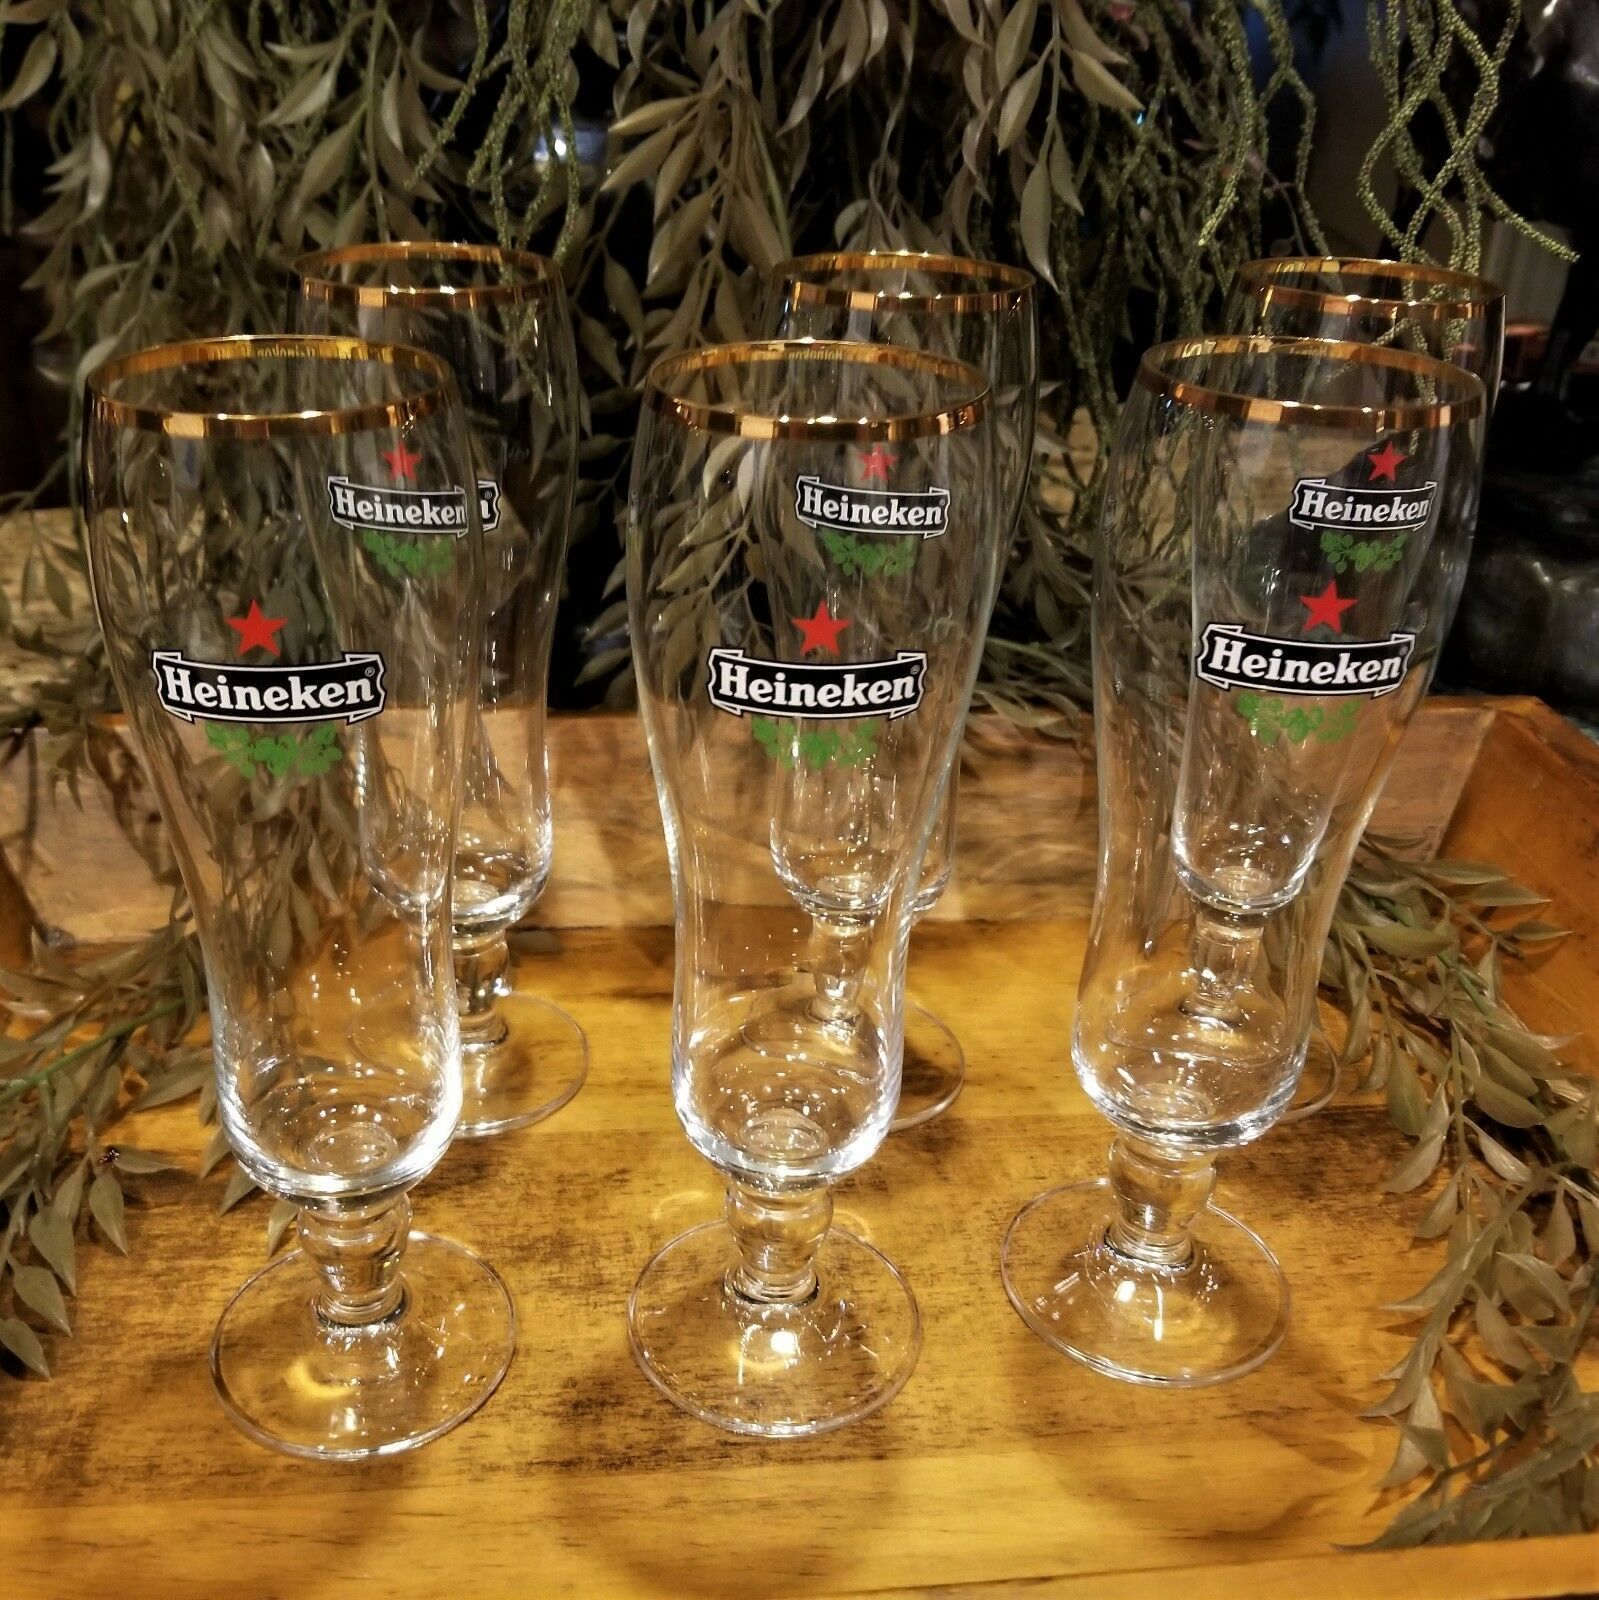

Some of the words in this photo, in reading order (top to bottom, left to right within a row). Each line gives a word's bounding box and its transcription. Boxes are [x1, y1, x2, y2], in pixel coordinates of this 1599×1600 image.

[802, 485, 942, 526] Heineken
[1208, 636, 1402, 685] Heineken
[719, 661, 915, 708] Heineken
